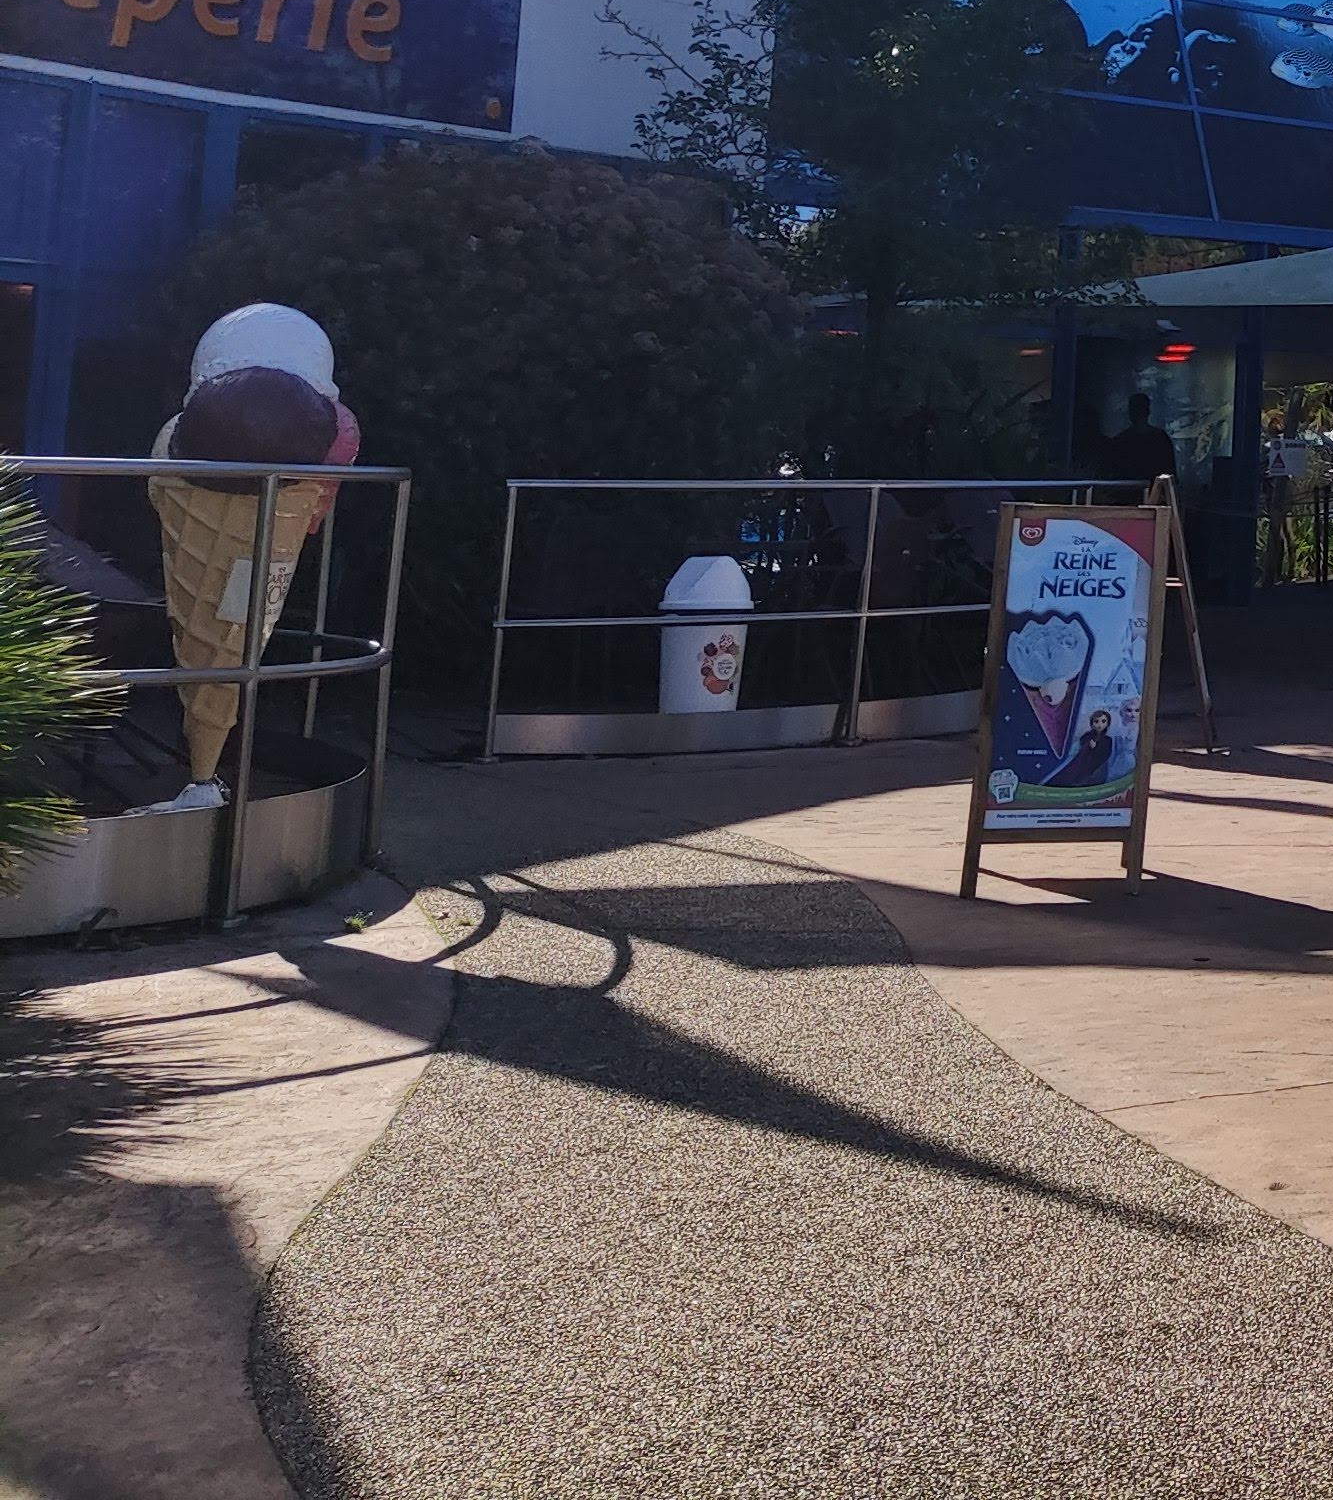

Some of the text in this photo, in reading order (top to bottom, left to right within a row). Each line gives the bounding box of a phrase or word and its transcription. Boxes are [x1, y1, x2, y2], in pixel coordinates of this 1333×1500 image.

[1072, 535, 1099, 547] Disney
[1053, 551, 1118, 571] REINE
[1039, 575, 1126, 599] NEIGES
